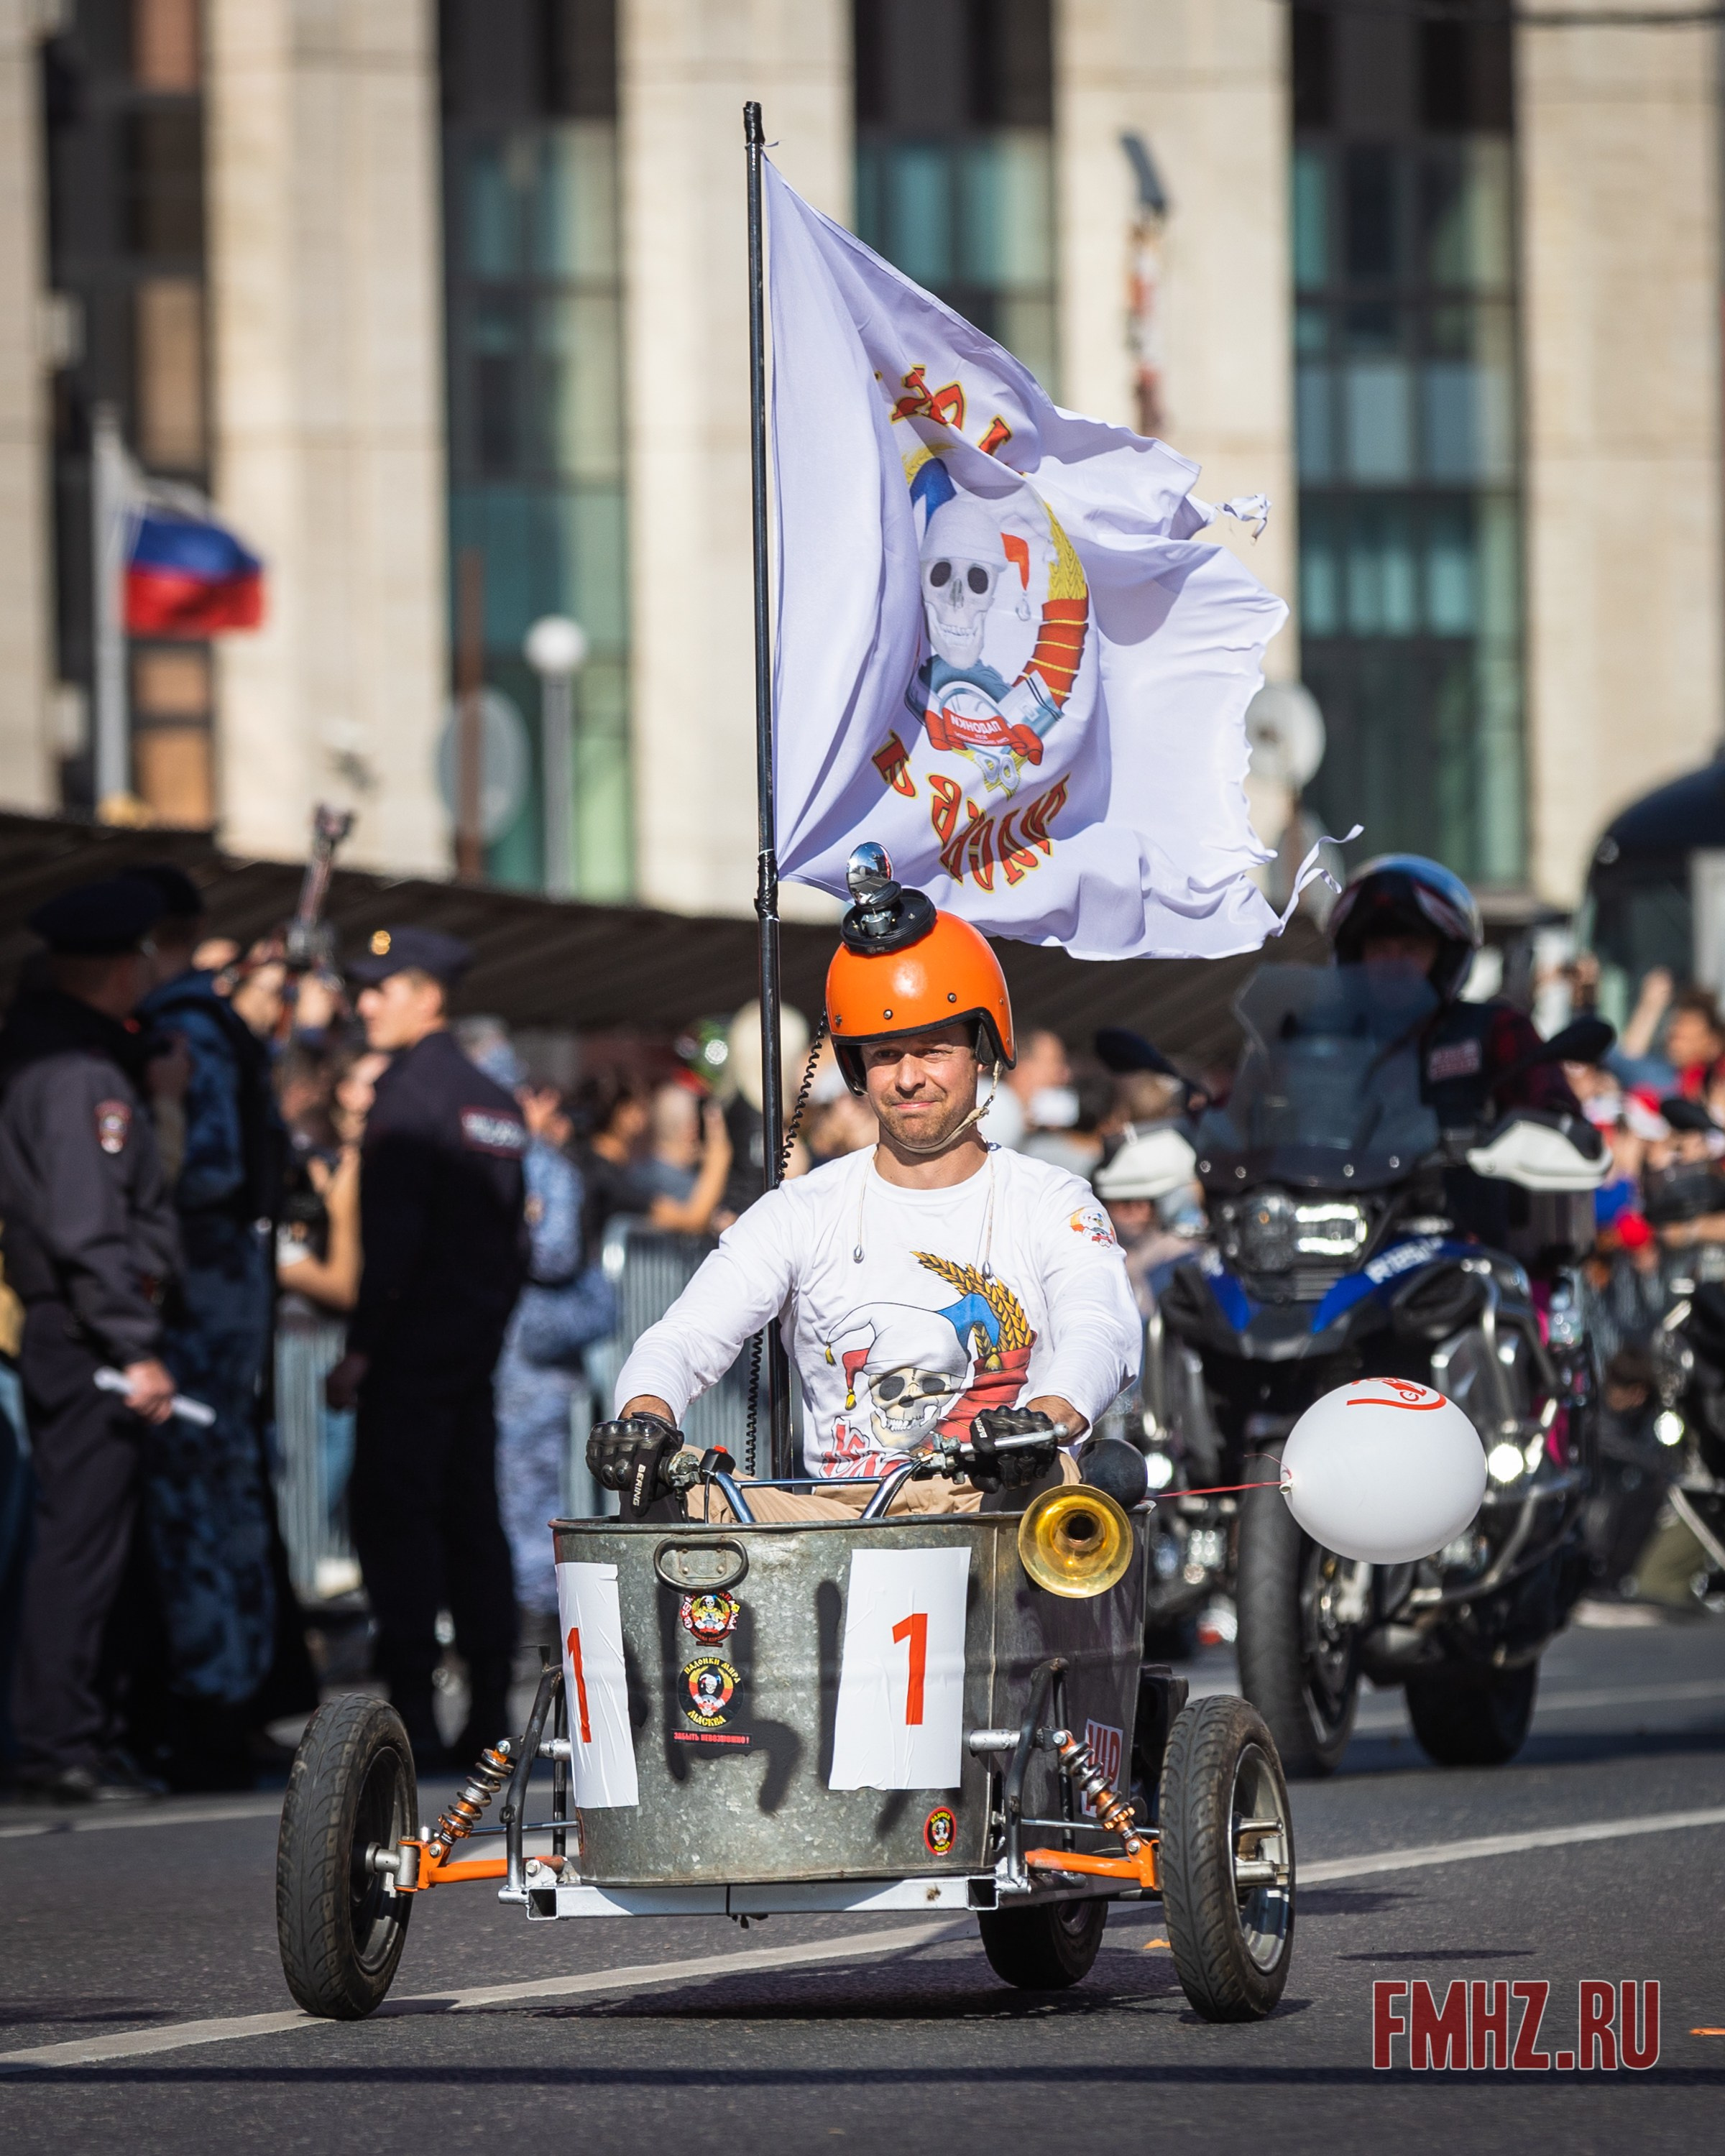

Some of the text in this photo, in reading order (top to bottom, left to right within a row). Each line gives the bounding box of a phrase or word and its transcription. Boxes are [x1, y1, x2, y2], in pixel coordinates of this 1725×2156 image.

[632, 1463, 646, 1506] BERING
[684, 1657, 720, 1674] ПАДОНКИ
[892, 1613, 928, 1725] 1
[567, 1626, 592, 1743] 1
[687, 1710, 727, 1727] МАСКВА
[673, 1731, 699, 1741] ЗАБЫТЬ
